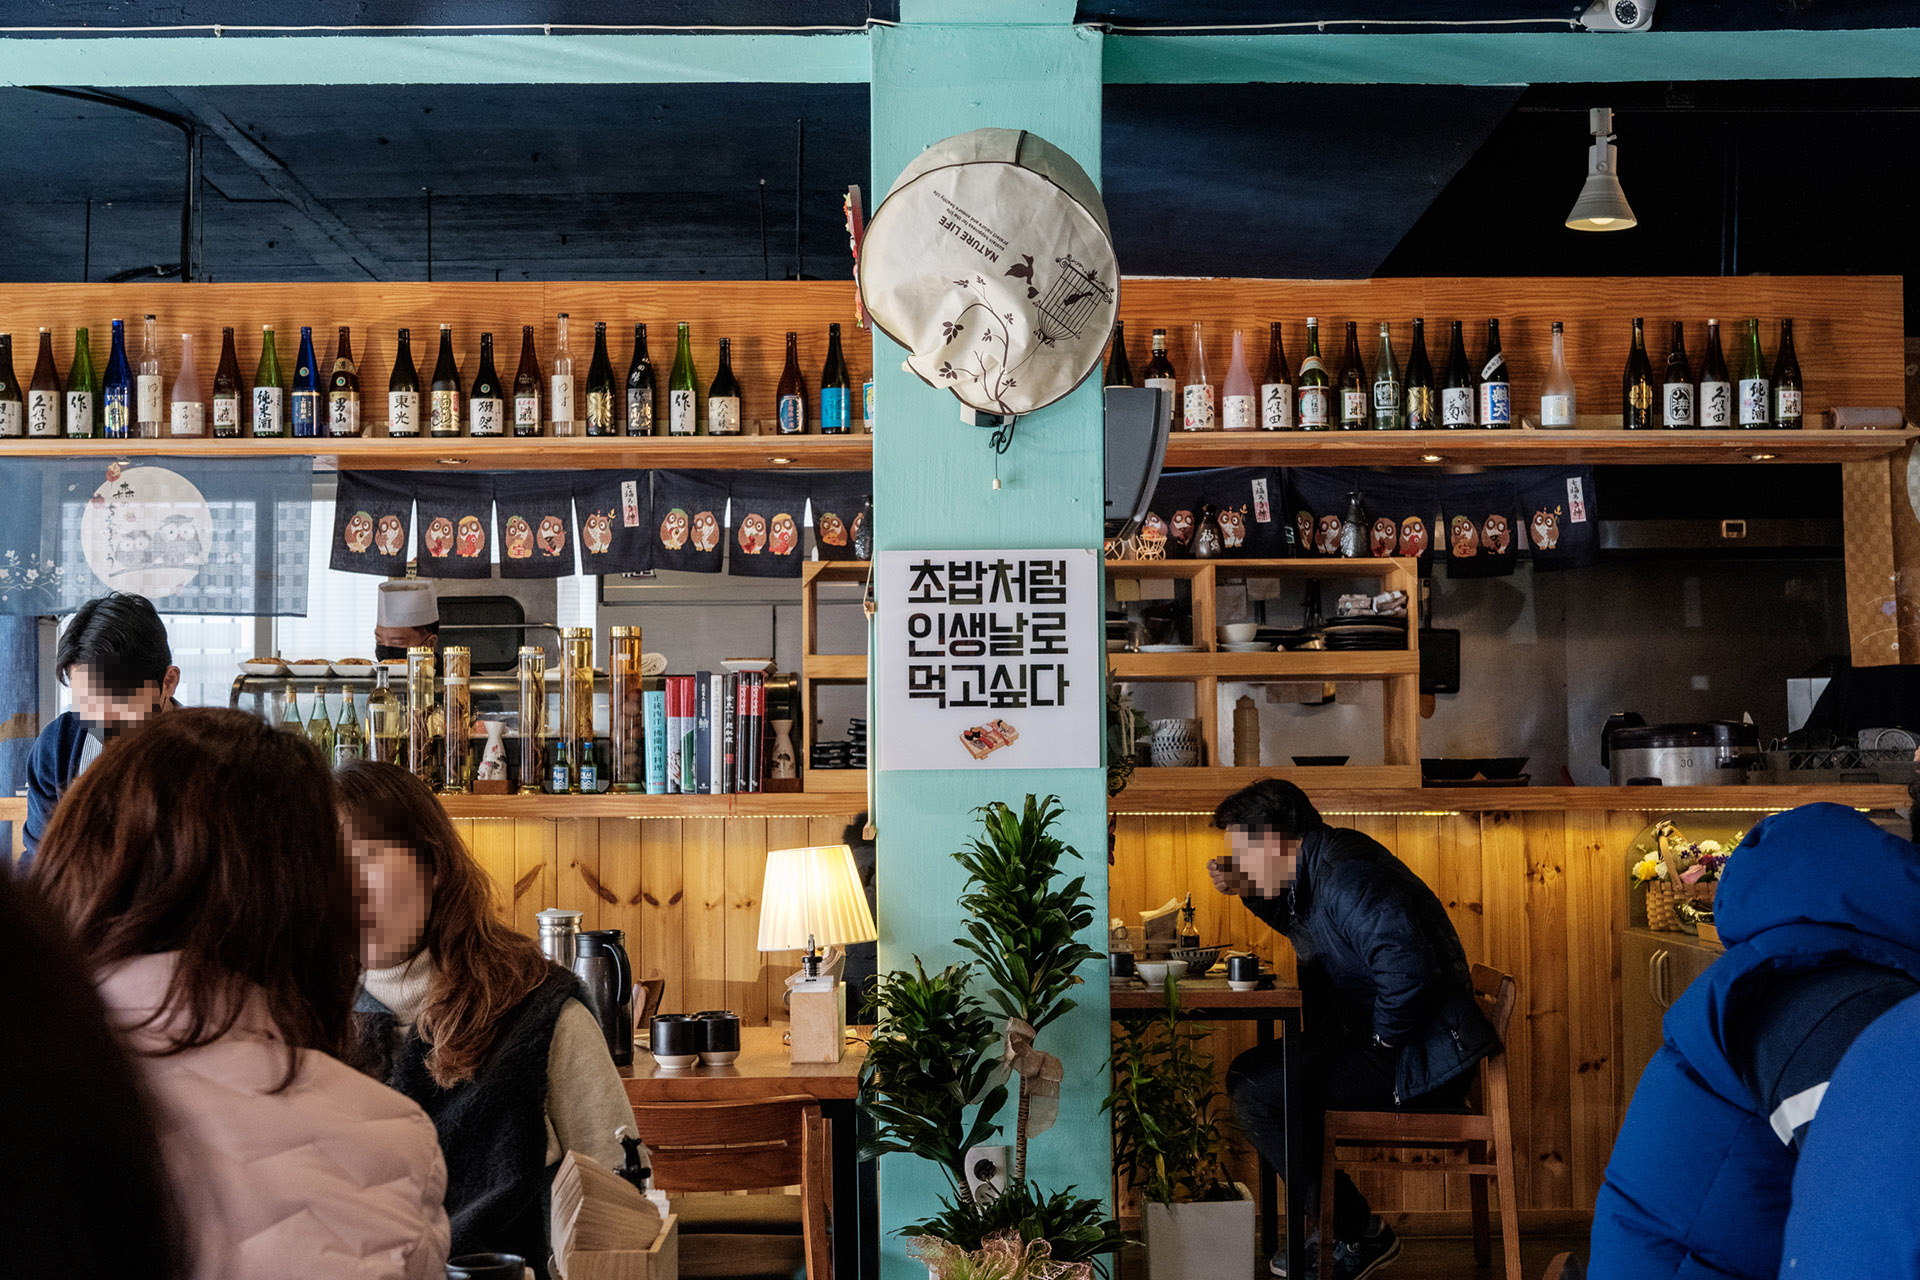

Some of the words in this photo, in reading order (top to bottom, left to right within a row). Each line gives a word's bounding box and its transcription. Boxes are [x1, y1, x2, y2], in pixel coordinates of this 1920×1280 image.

[932, 189, 942, 198] life
[939, 194, 956, 209] healthy
[946, 207, 955, 217] life
[953, 212, 962, 221] the
[954, 206, 972, 219] ensure
[960, 218, 969, 226] for
[969, 216, 980, 225] and
[937, 215, 962, 236] LIFE
[967, 222, 990, 241] happiness
[978, 222, 994, 235] nature
[959, 230, 1000, 264] NATURE
[988, 238, 1005, 252] sustain
[991, 232, 1010, 246] protect
[257, 390, 273, 429] 純米酒
[335, 397, 347, 424] 男山
[394, 394, 410, 425] 東光
[1264, 387, 1282, 425] 久保田
[1709, 386, 1726, 423] 久保田
[1750, 382, 1766, 421] 純米酒
[31, 394, 47, 432] 久保田
[908, 559, 1067, 605] 초밥처럼
[908, 612, 1069, 657] 인생날로
[908, 664, 1070, 709] 먹고싶다
[1680, 758, 1694, 768] 30
